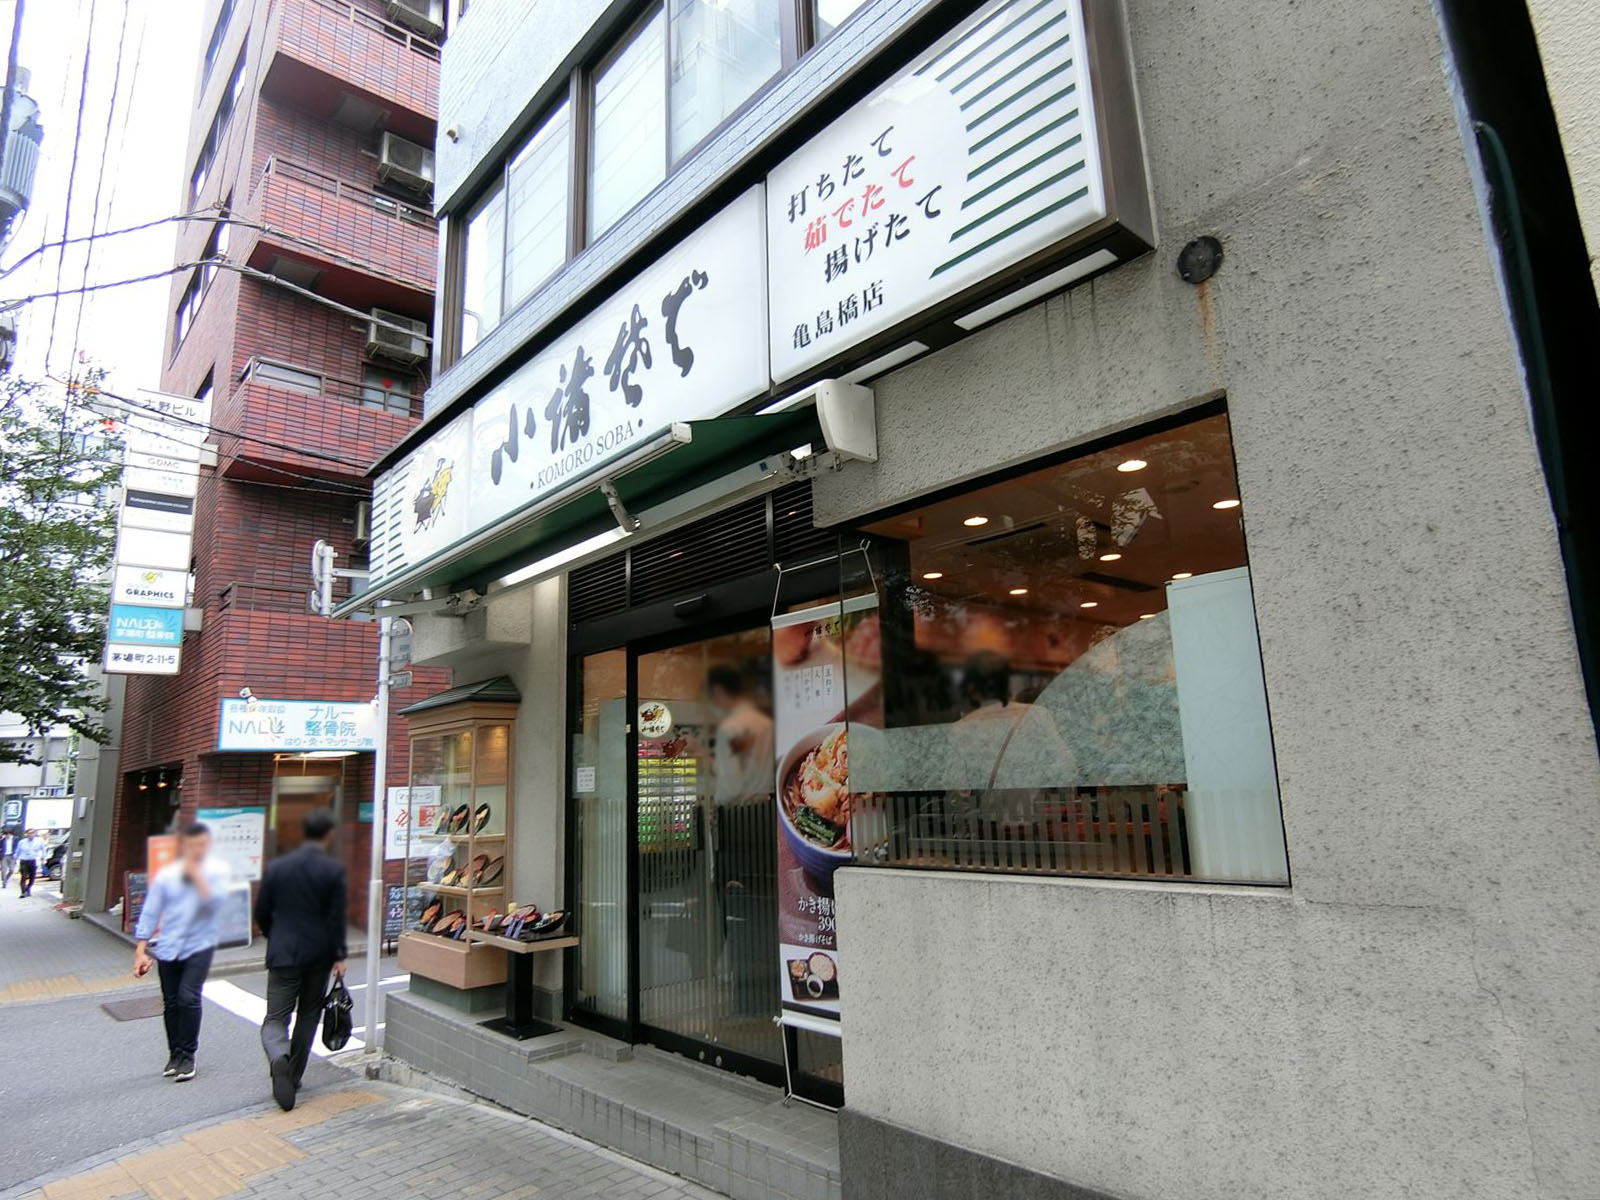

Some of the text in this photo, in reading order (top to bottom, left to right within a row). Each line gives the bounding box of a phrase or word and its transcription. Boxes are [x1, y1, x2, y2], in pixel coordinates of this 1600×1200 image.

[788, 126, 894, 223] 打ちたて
[804, 155, 916, 256] 茹でたて
[824, 185, 943, 283] 揚げたて
[792, 280, 884, 350] 亀島橋店
[536, 420, 635, 490] KOMORO SOBA
[125, 588, 175, 599] GRAPHICS
[304, 721, 357, 737] 整骨院
[308, 705, 355, 720] ナルー
